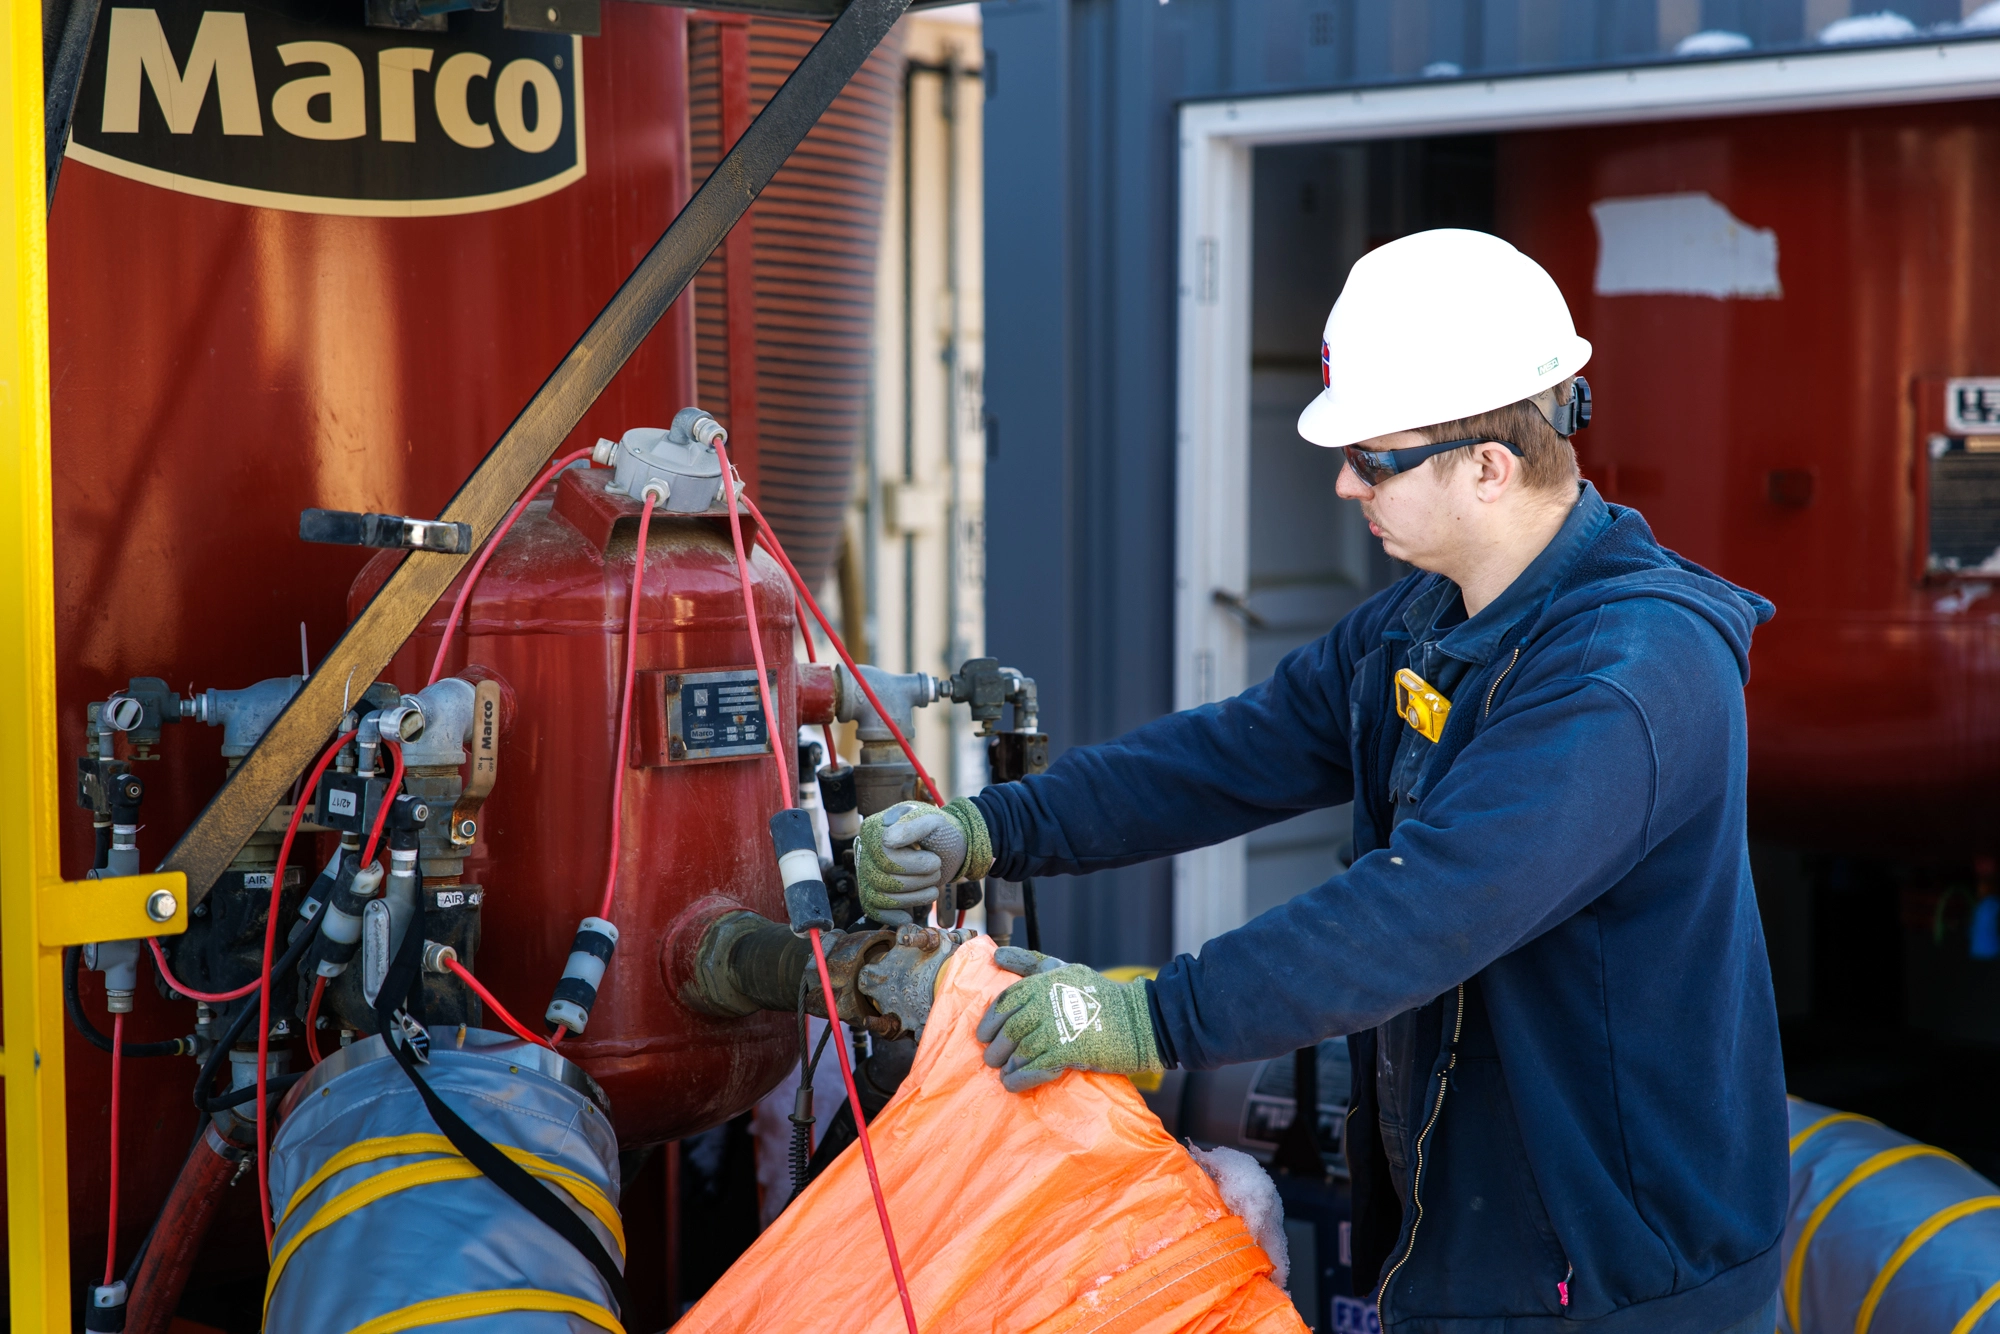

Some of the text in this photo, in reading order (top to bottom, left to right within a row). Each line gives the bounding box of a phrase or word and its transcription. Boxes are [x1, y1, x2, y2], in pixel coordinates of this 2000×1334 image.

[101, 7, 563, 154] Marco
[1539, 358, 1559, 376] MSA
[482, 700, 493, 750] Marco
[692, 730, 713, 738] Marco
[478, 762, 483, 771] ON
[332, 797, 351, 809] 42/17
[248, 875, 267, 885] AIR
[443, 894, 463, 905] AIR
[1066, 989, 1085, 1027] IRONCAT
